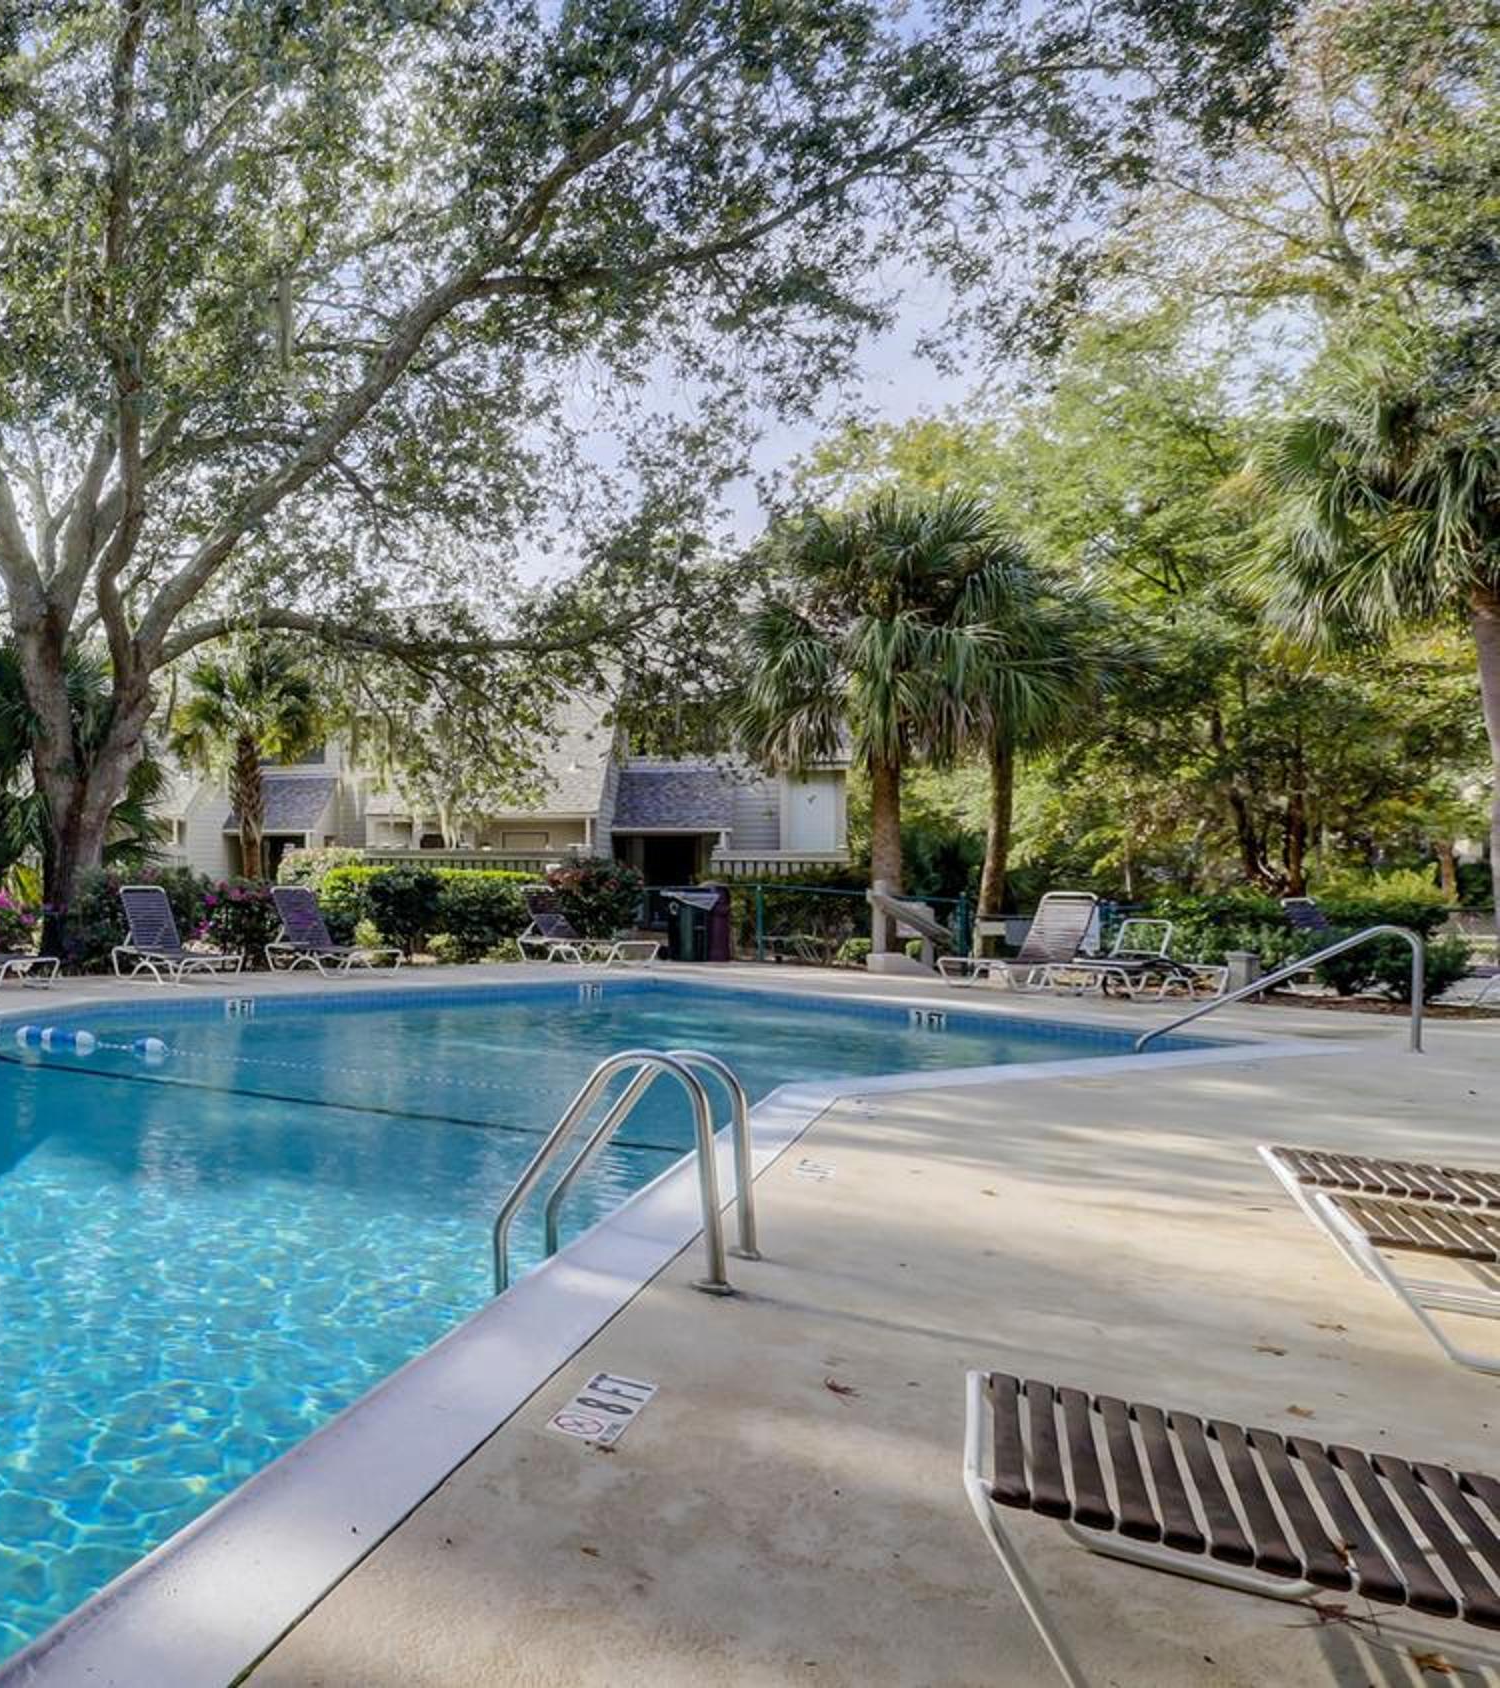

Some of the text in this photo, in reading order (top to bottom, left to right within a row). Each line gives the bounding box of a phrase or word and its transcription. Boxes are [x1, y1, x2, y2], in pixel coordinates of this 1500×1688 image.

[928, 1012, 943, 1027] FT
[588, 1373, 653, 1402] FT
[576, 1397, 633, 1415] 8
